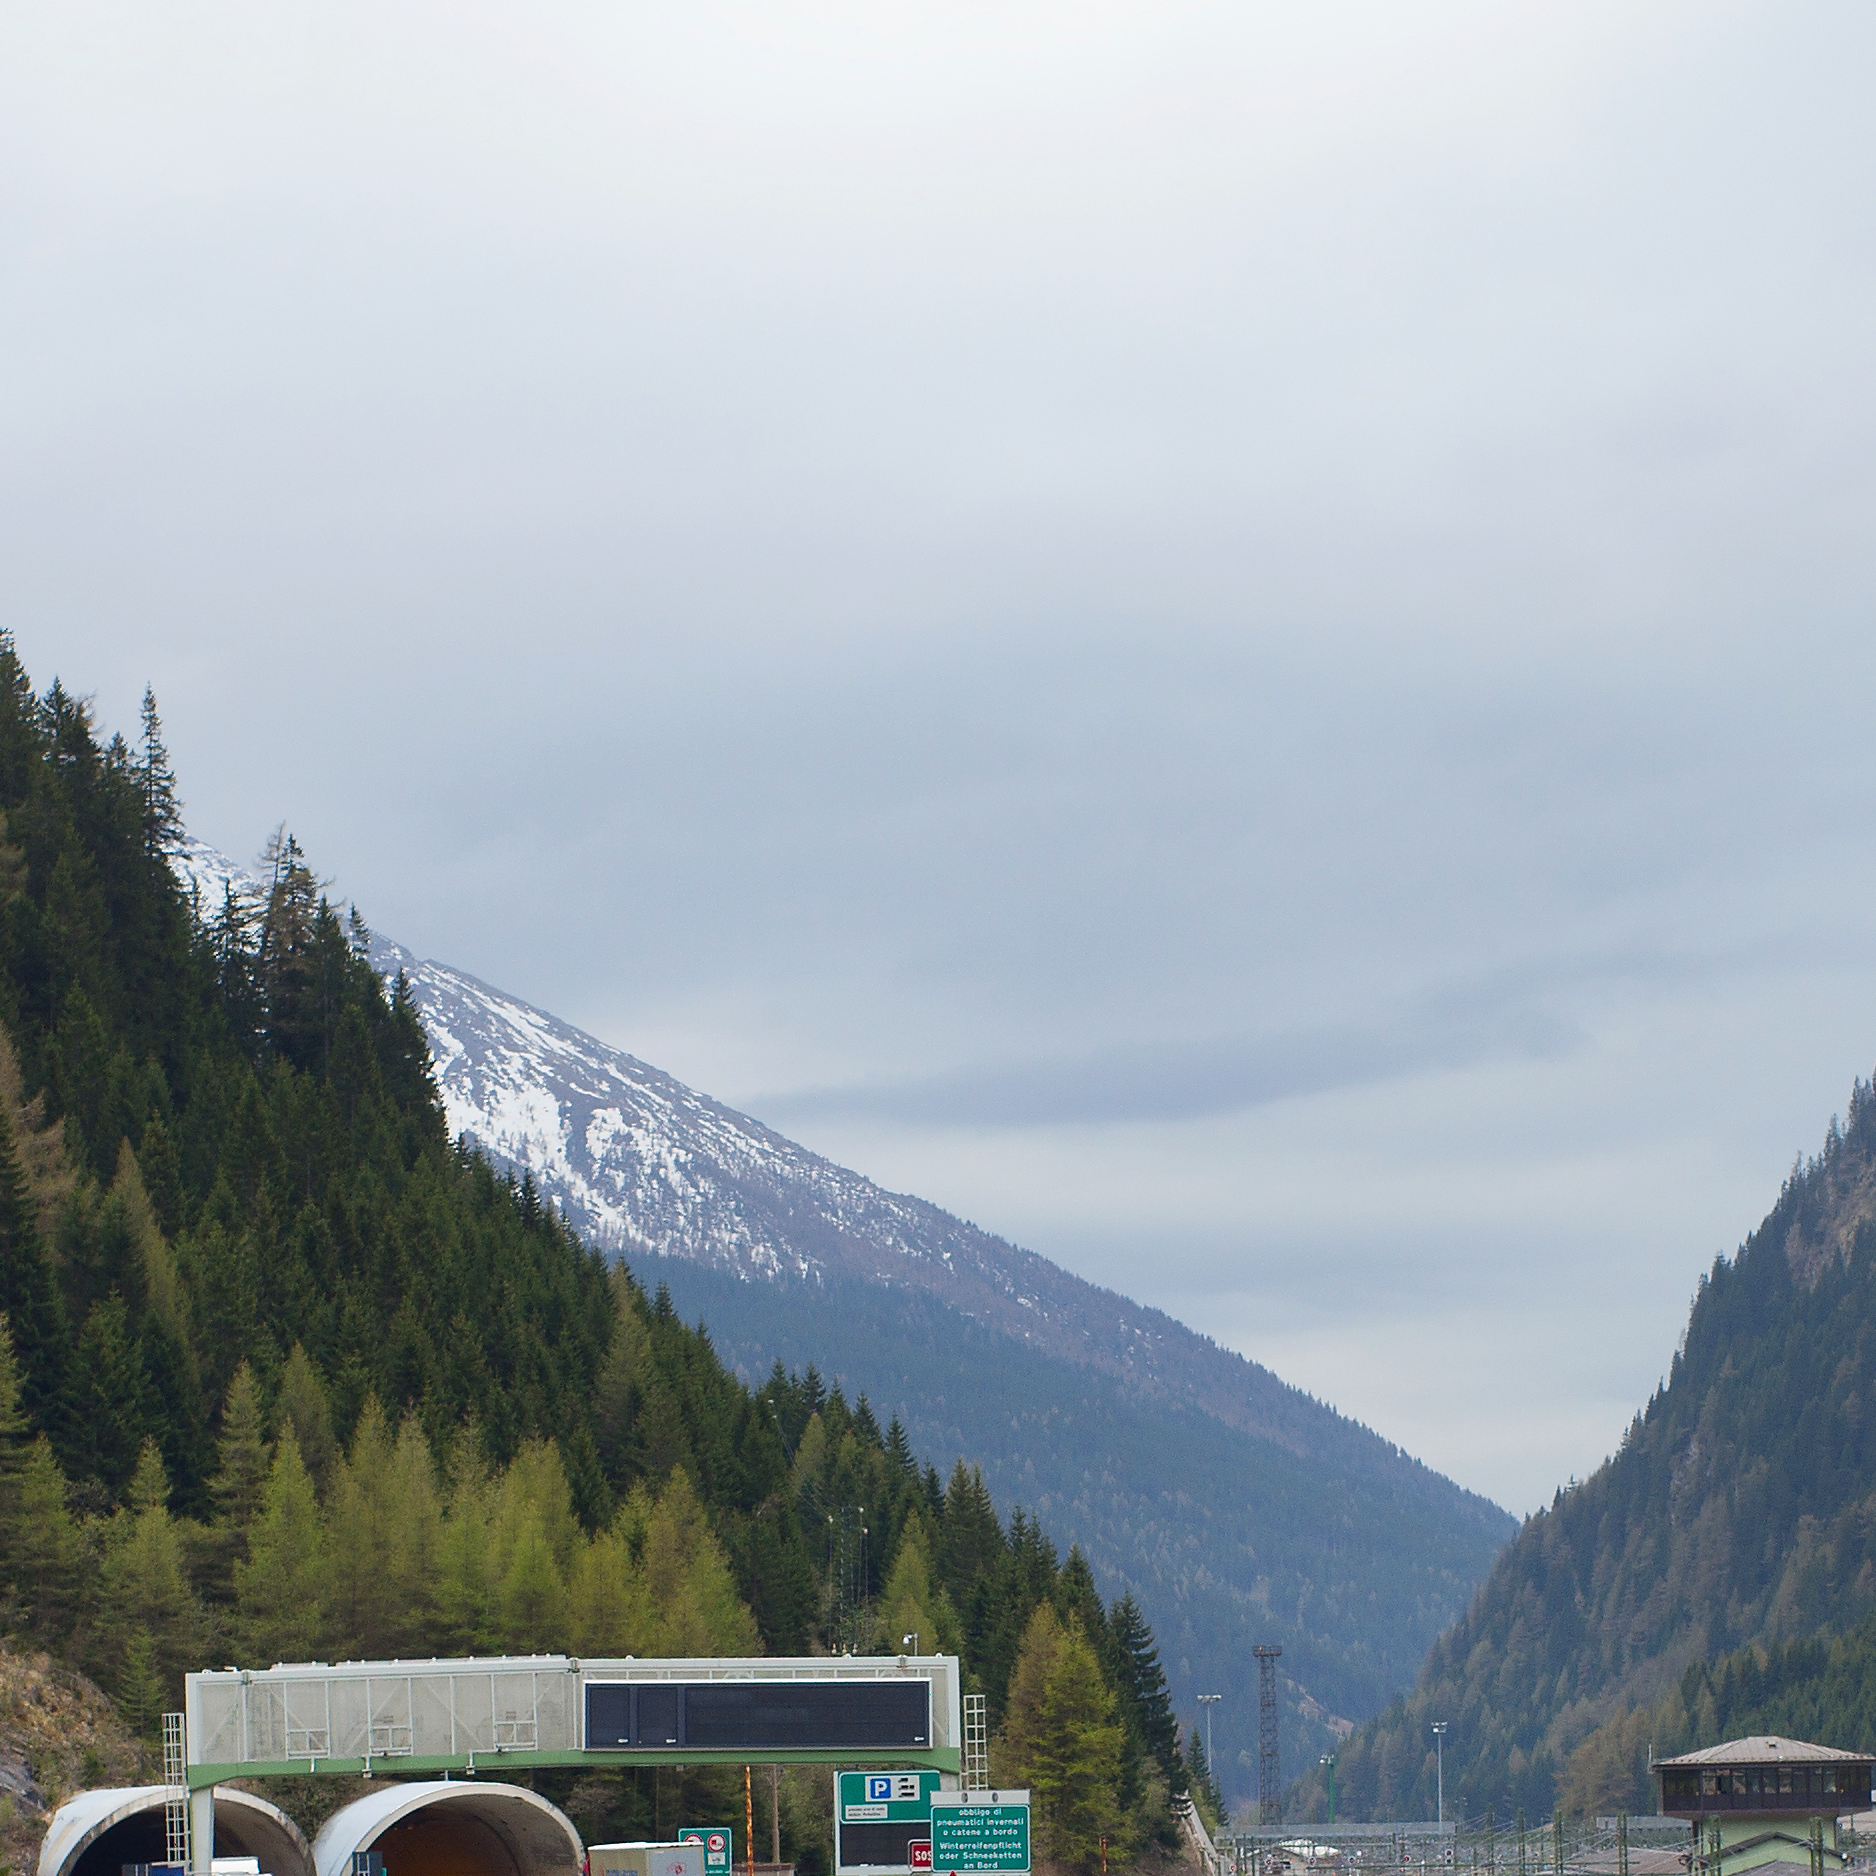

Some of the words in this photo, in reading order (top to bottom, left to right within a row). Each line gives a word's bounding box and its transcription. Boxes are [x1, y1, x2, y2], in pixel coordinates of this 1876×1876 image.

[958, 1808, 990, 1817] obbligo
[993, 1808, 1002, 1816] di
[937, 1818, 984, 1827] pneumatici
[987, 1818, 1024, 1826] invernali
[993, 1827, 1018, 1836] bordo
[939, 1842, 1022, 1850] Winterreifenpflicht
[939, 1852, 959, 1860] oder
[962, 1852, 1022, 1860] Schneeketten
